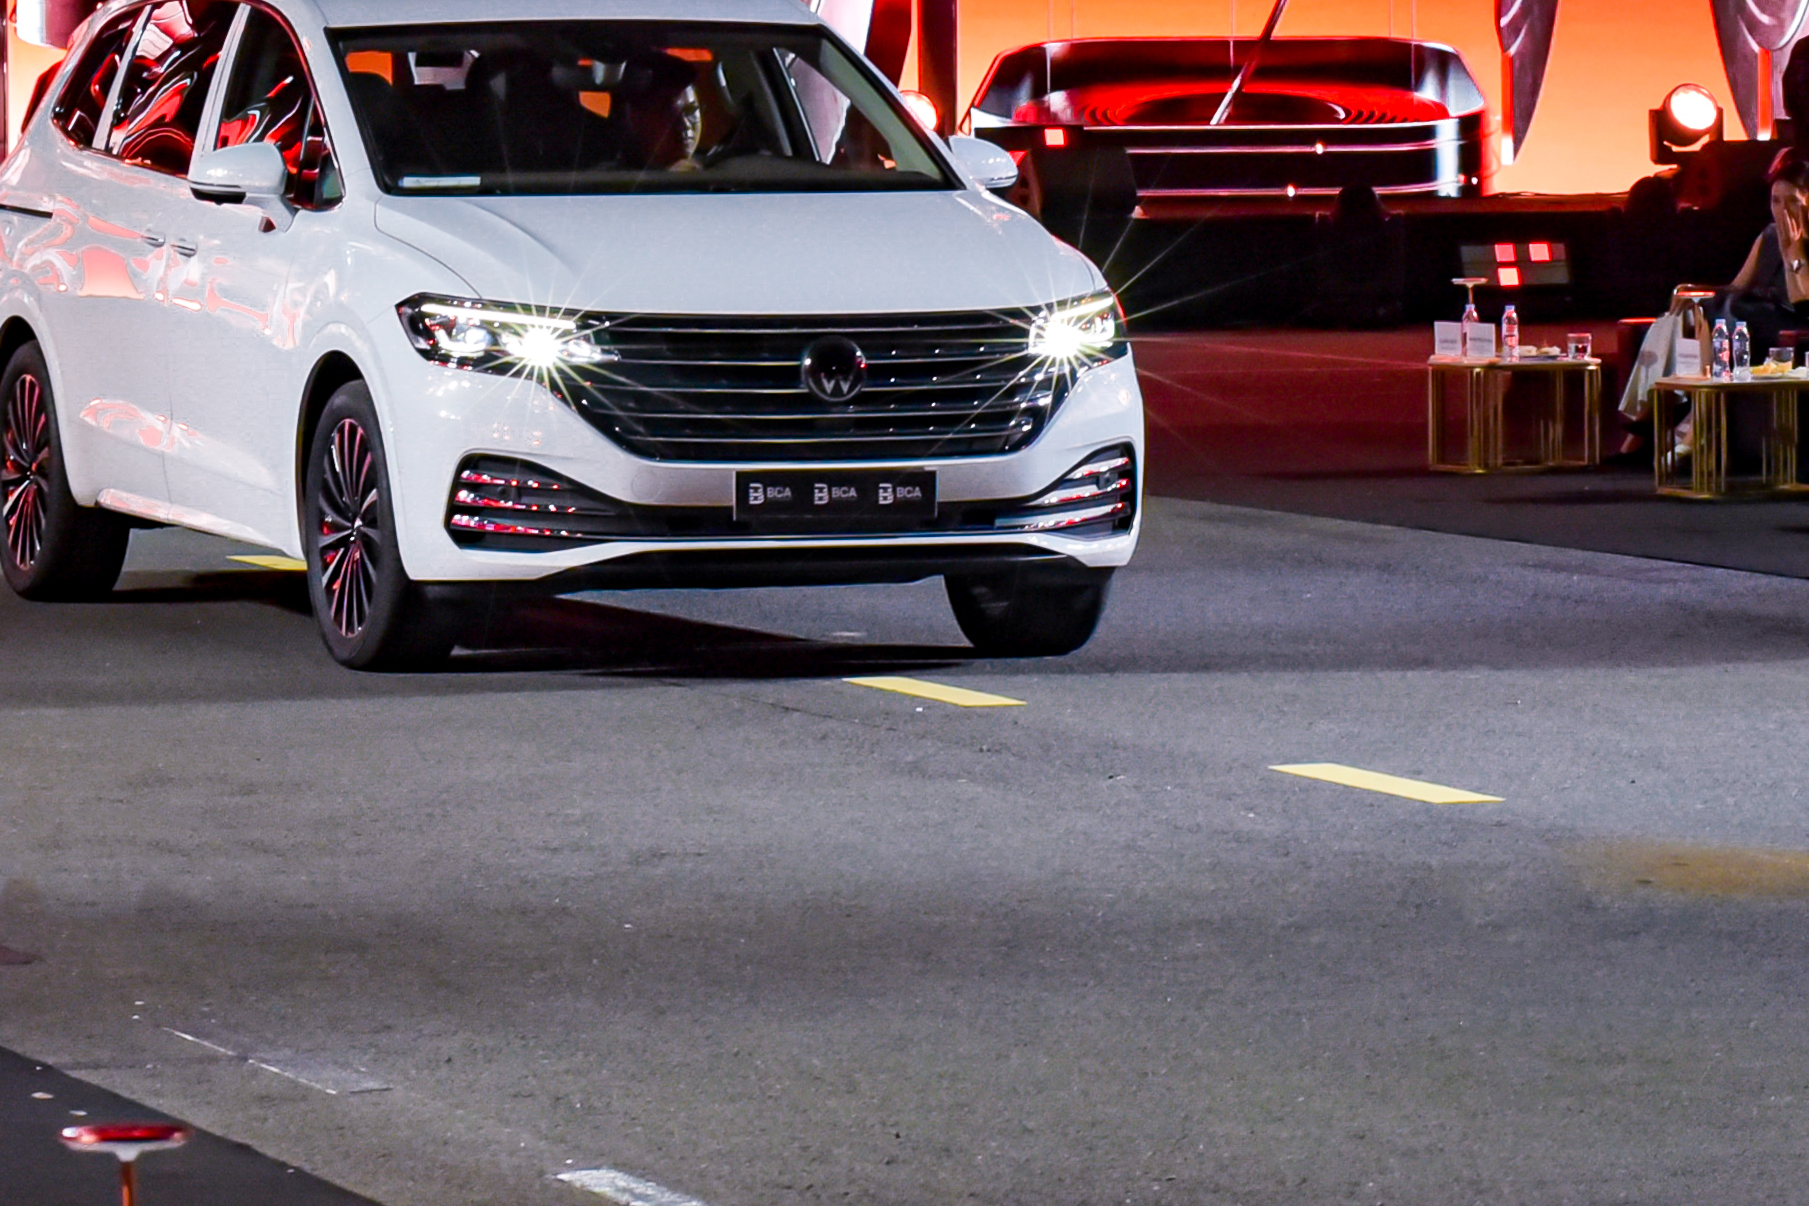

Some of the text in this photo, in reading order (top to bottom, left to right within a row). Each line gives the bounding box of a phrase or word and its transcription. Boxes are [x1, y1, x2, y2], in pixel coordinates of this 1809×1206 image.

[766, 486, 792, 498] BCA
[831, 486, 858, 498] BCA
[896, 486, 923, 498] BCA
